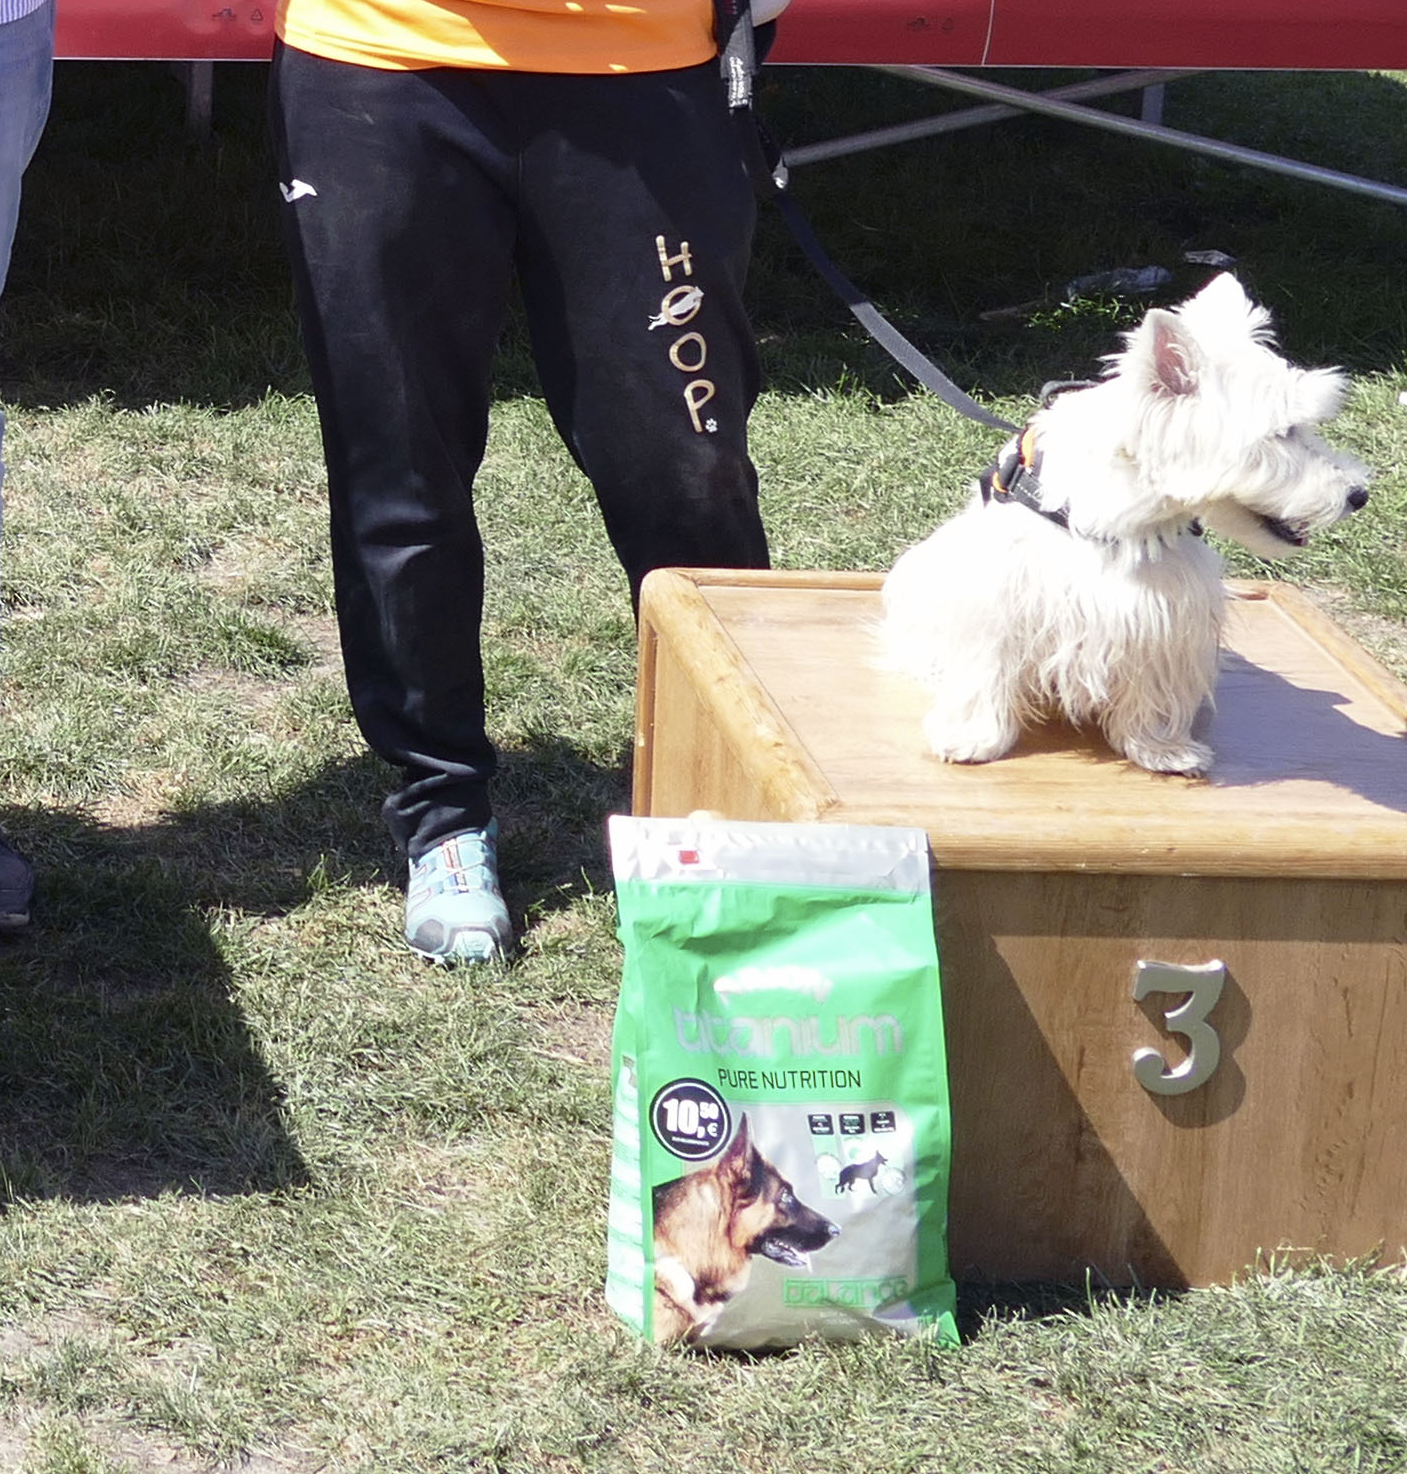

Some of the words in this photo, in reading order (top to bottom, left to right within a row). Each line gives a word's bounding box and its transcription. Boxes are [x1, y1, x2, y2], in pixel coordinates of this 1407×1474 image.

[671, 1004, 904, 1058] titanium
[1131, 958, 1226, 1095] 3
[717, 1068, 759, 1088] PURE
[761, 1070, 862, 1089] NUTRITION
